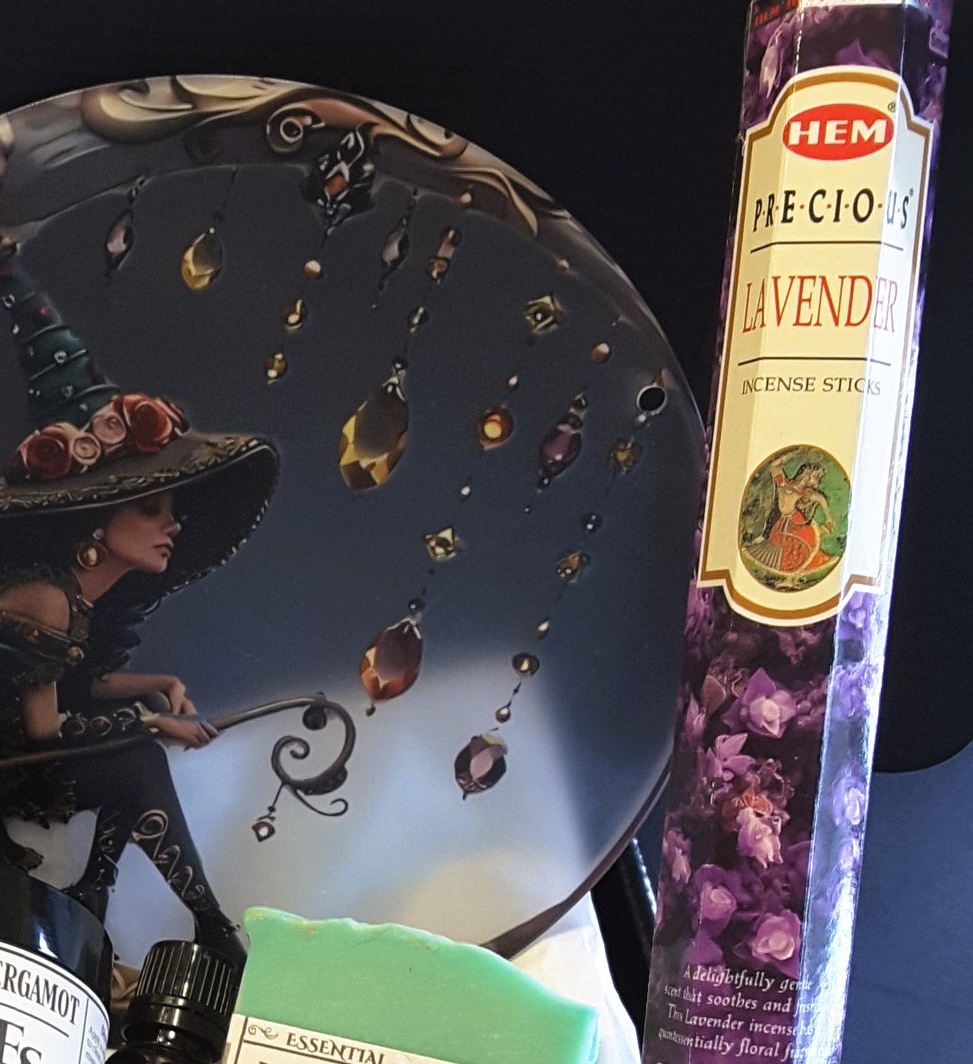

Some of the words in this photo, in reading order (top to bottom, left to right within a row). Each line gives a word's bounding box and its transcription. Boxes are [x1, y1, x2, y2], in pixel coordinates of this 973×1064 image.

[788, 119, 887, 145] HEM
[742, 275, 898, 333] LAVENDER
[741, 376, 815, 395] INCENSE
[822, 377, 881, 396] STICKS
[683, 965, 690, 979] A
[693, 965, 774, 991] delightfully
[707, 992, 757, 1010] soothes
[763, 997, 792, 1013] and
[685, 1009, 744, 1030] Lavender
[749, 1018, 797, 1036] incense
[736, 1037, 780, 1057] floral
